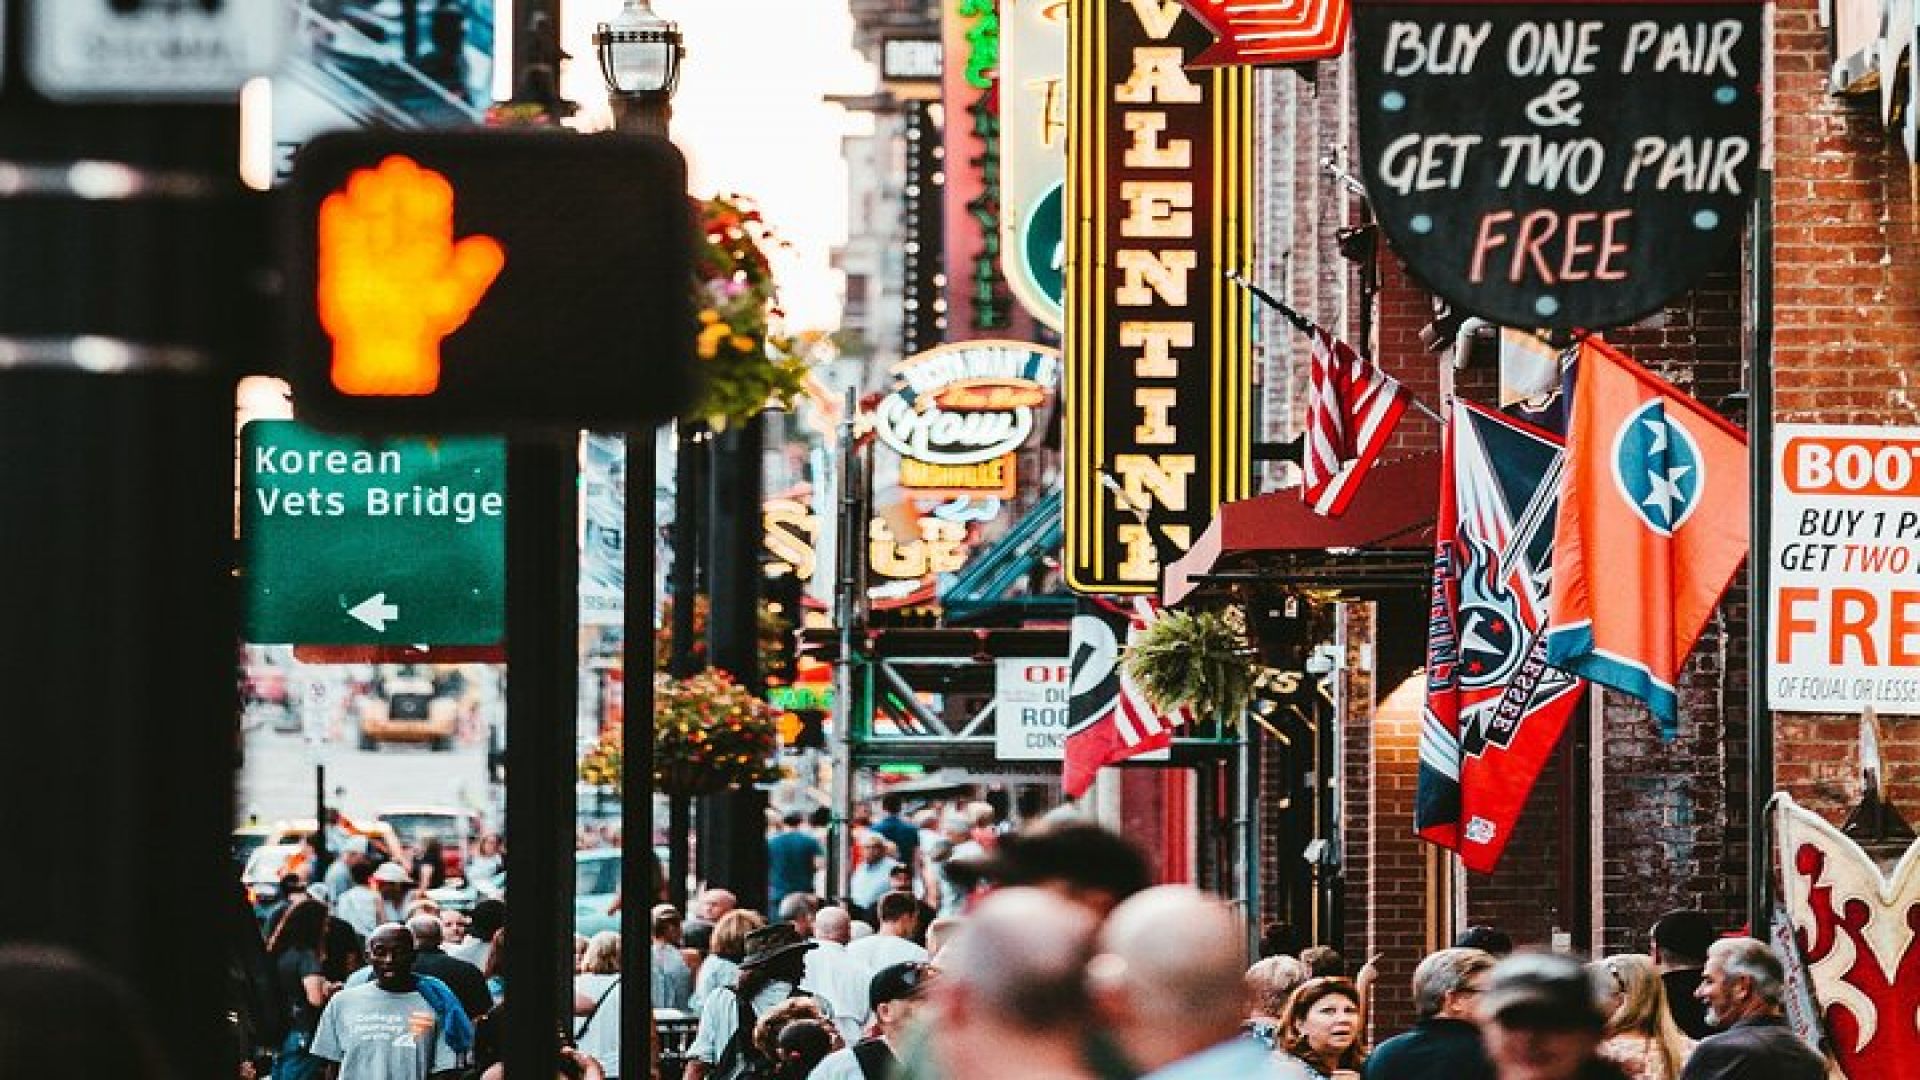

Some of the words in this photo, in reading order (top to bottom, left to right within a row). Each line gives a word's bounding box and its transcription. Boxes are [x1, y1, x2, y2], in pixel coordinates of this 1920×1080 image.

[1383, 20, 1492, 77] BUY
[1507, 20, 1604, 76] ONE
[1620, 20, 1743, 78] PAIR
[1526, 78, 1583, 126] &
[1379, 133, 1482, 195] GET
[1497, 135, 1603, 194] TWO
[1623, 136, 1749, 195] PAIR
[1469, 209, 1633, 284] FREE
[255, 446, 401, 474] Korean
[1796, 444, 1920, 491] BOO
[255, 487, 345, 516] Vets
[366, 486, 503, 522] Bridge
[1799, 508, 1864, 537] BUY
[1874, 512, 1886, 538] 1
[1780, 543, 1838, 571] GET
[1843, 544, 1910, 574] TWO
[1775, 587, 1920, 667] FRE
[1800, 677, 1848, 700] EQUAL
